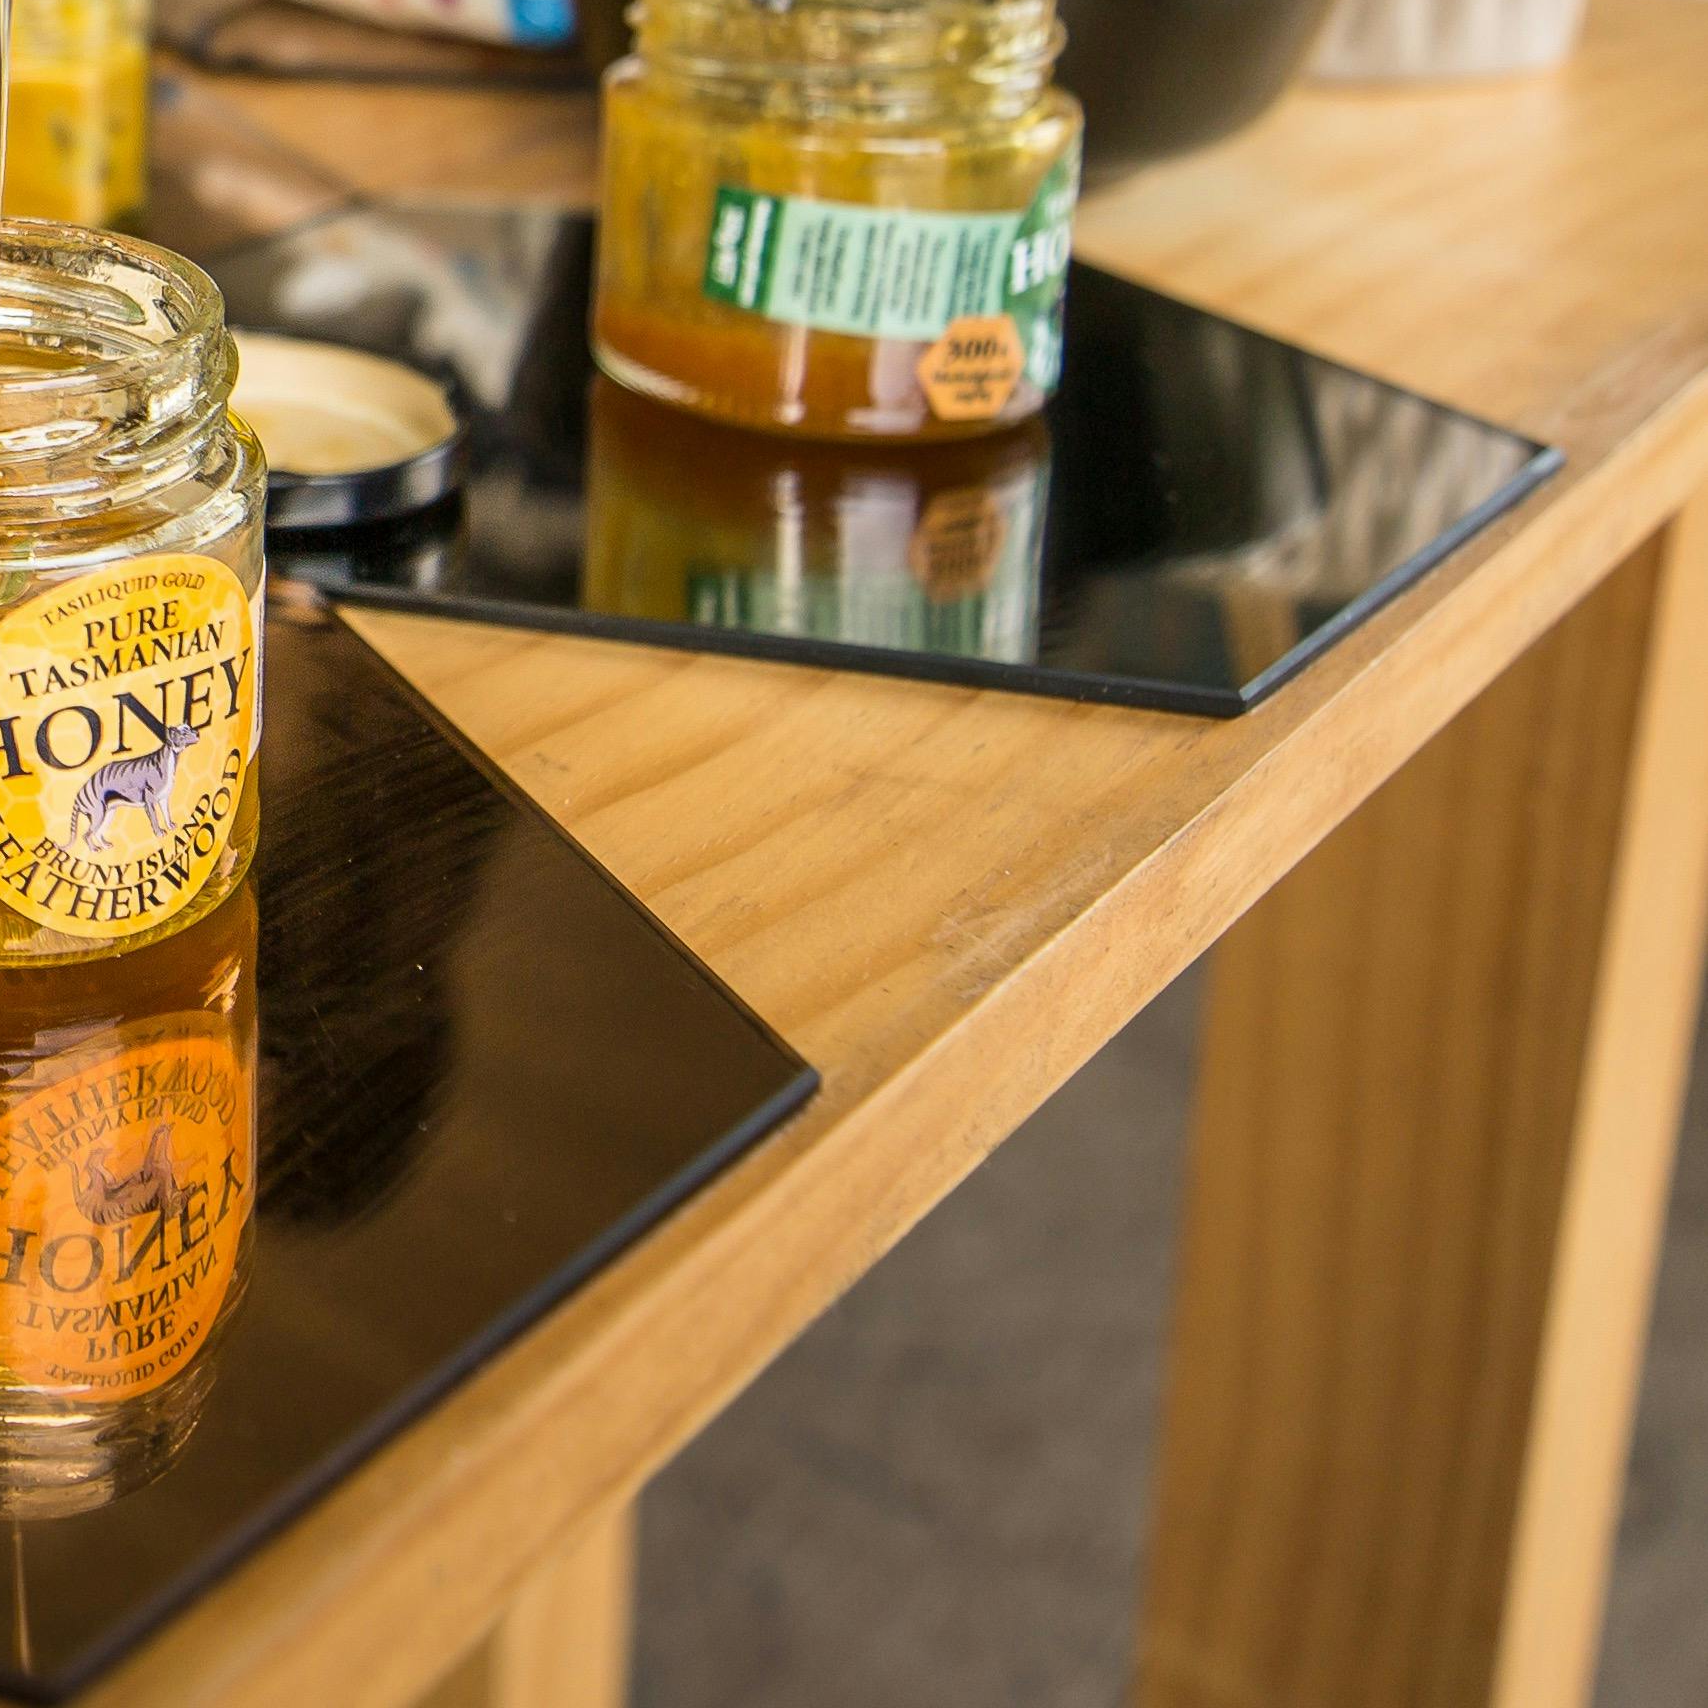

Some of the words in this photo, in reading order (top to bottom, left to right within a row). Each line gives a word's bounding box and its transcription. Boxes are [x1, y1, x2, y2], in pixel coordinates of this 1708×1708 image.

[162, 571, 205, 591] GOLD
[84, 600, 180, 650] PURE
[10, 620, 226, 700] TASMANIAN
[31, 836, 132, 885] BRUNY
[137, 793, 211, 881] ISLAND
